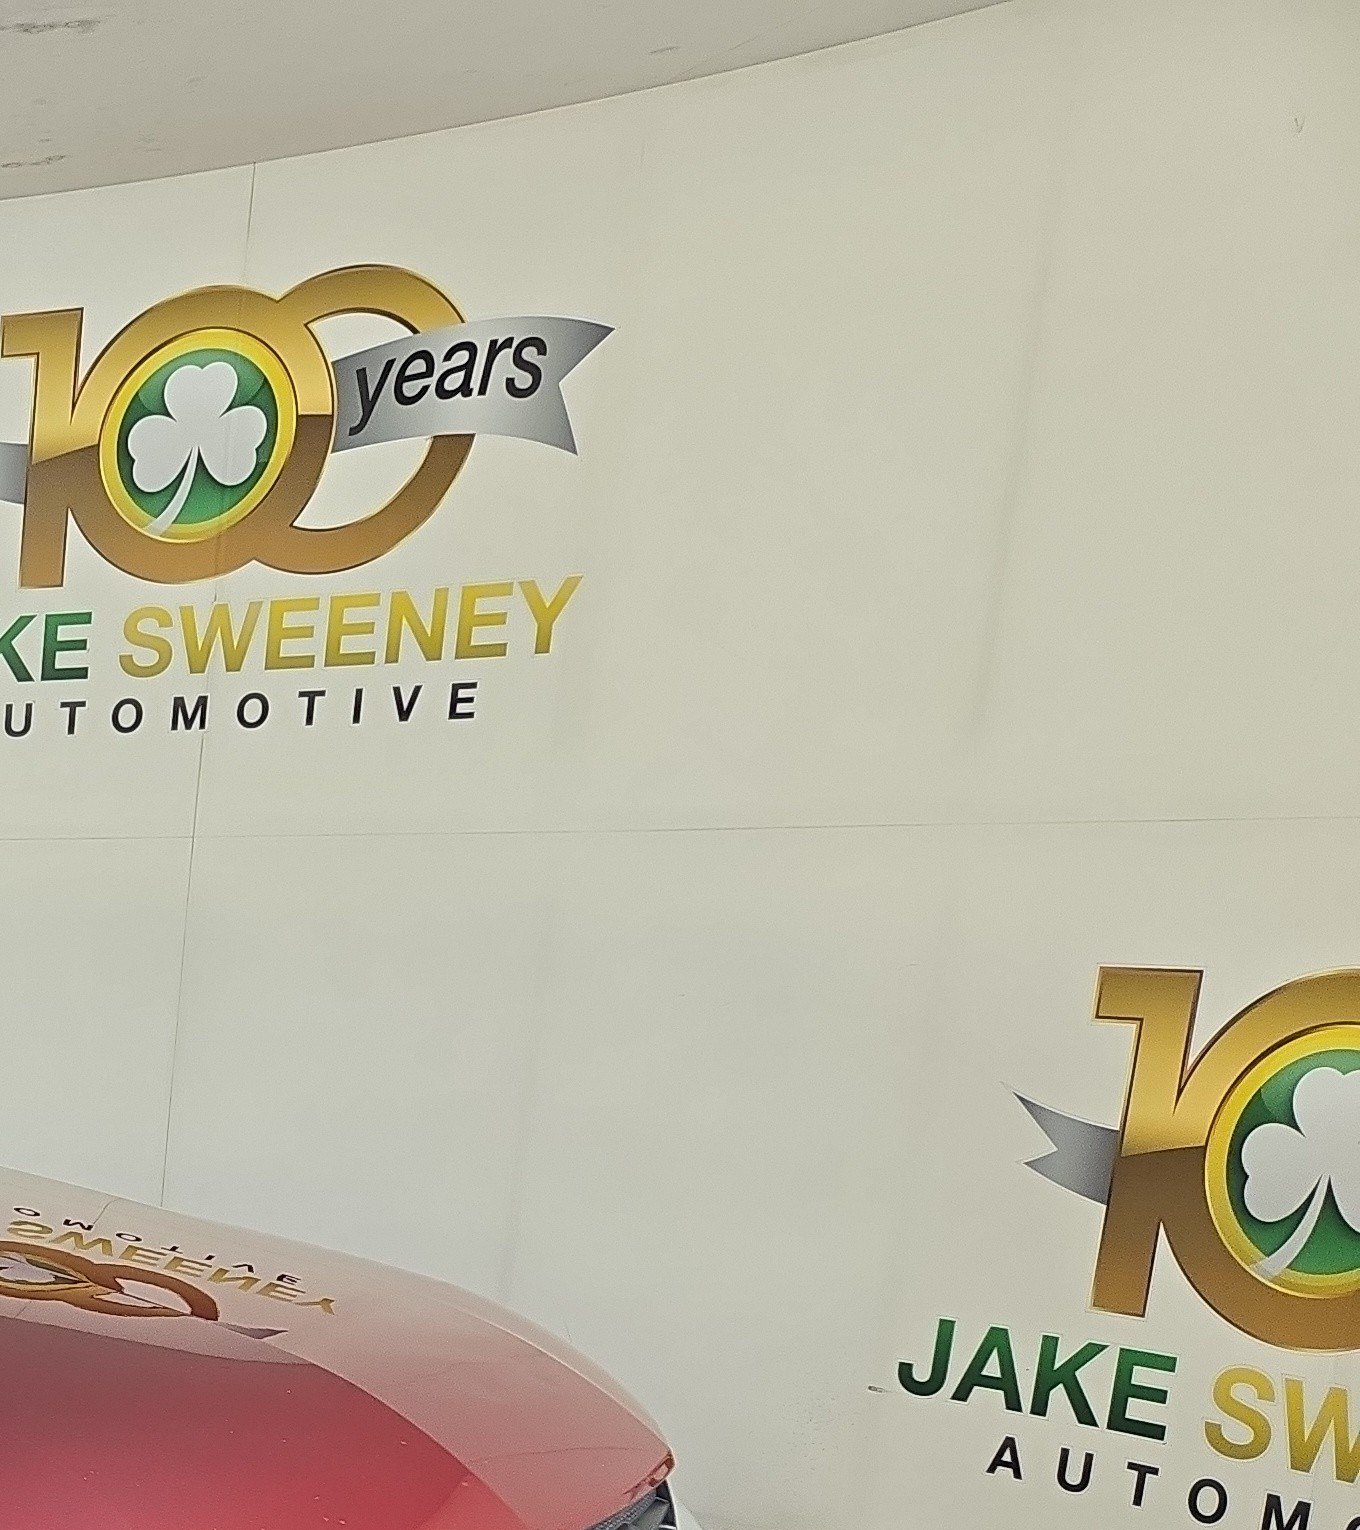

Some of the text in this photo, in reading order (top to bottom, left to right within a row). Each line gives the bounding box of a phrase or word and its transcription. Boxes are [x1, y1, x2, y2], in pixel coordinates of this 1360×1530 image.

[348, 334, 547, 437] years
[118, 575, 584, 680] SWEENEY
[897, 1318, 1178, 1441] JAKE
